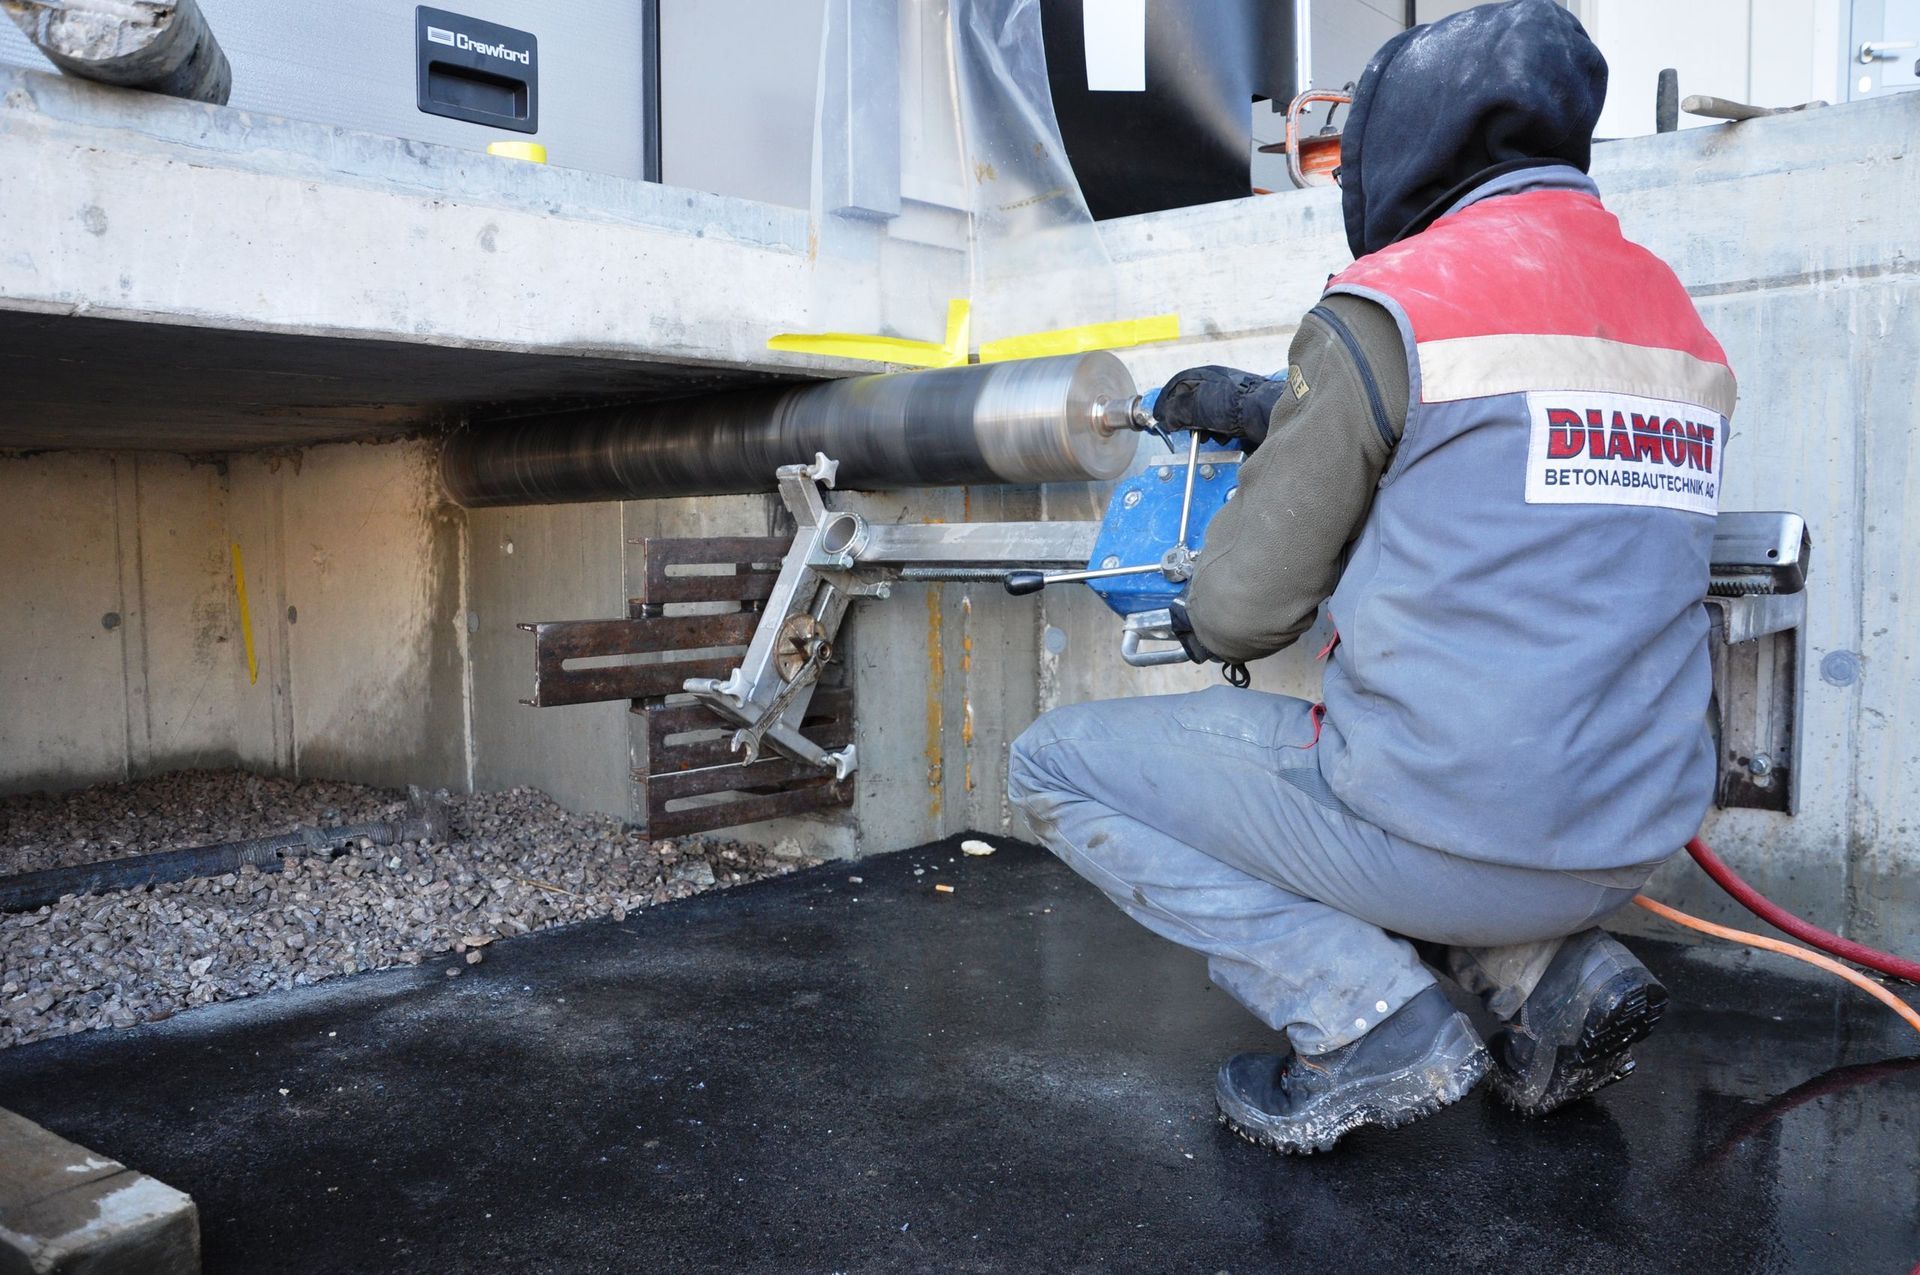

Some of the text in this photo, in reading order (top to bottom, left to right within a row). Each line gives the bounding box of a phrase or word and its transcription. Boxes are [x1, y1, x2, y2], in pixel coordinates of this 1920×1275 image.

[456, 33, 529, 65] Crawford
[1546, 408, 1714, 473] DIAMONT
[1545, 468, 1714, 499] BETONABBAUTECHNIK AG
